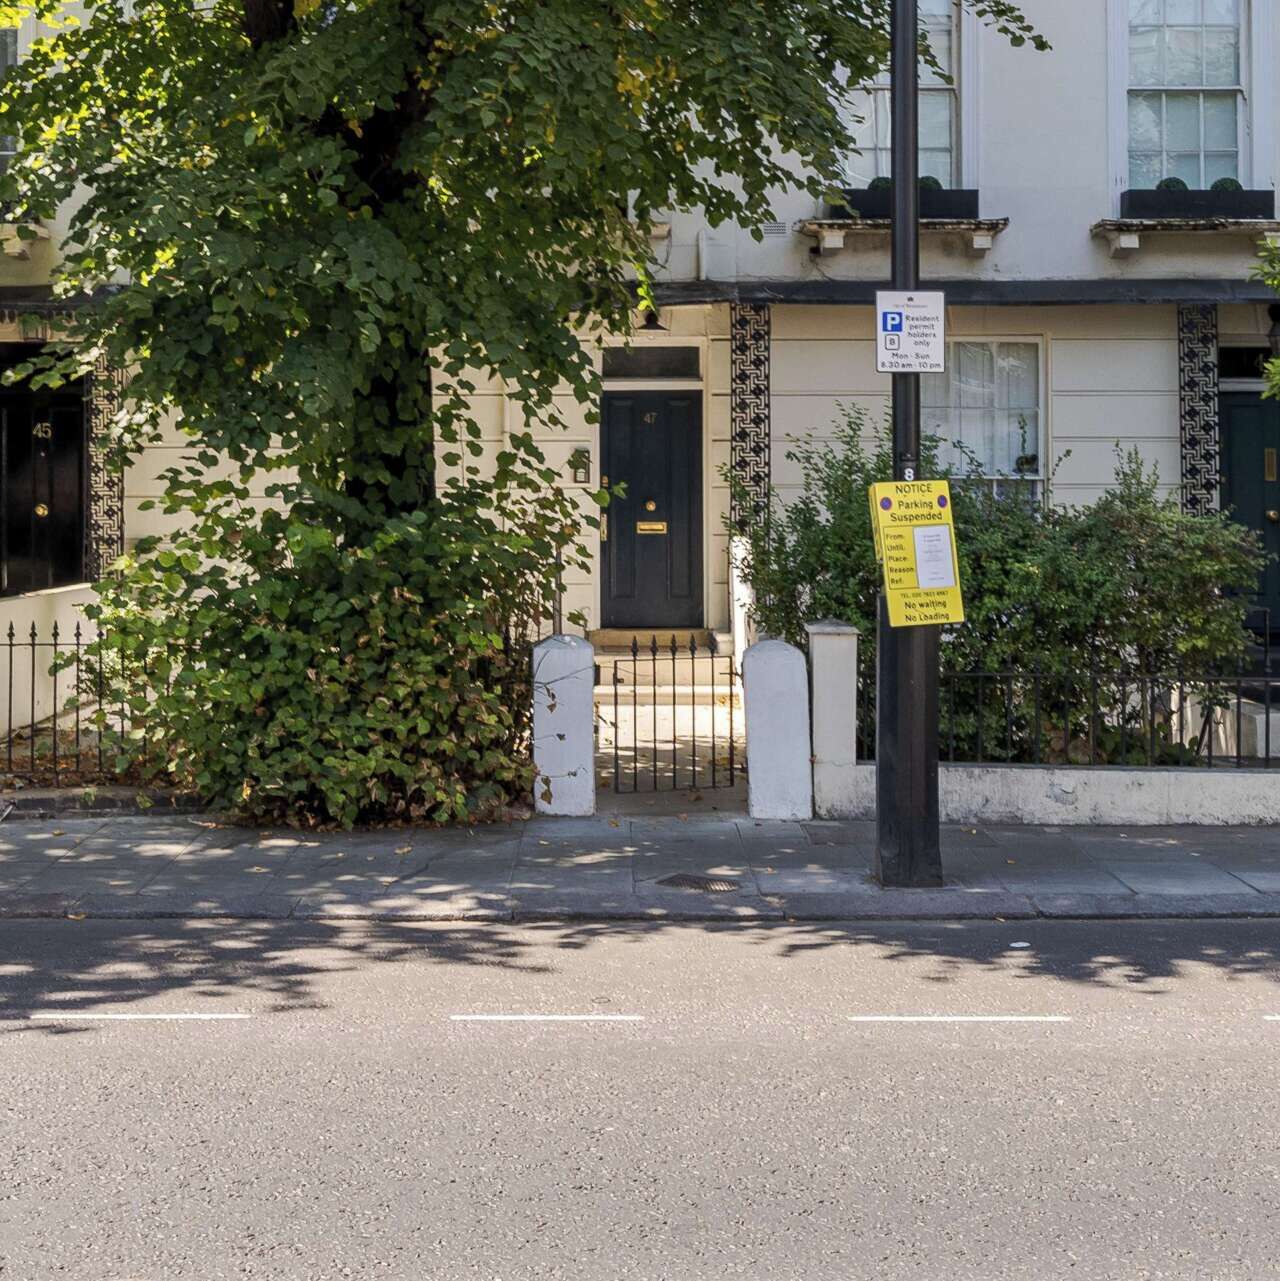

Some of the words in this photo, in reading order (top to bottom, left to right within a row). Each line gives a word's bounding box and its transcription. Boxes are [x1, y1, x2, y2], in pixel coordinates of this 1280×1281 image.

[887, 313, 901, 331] P
[905, 314, 940, 322] Resident
[909, 323, 935, 331] permit
[913, 339, 931, 347] only
[891, 352, 909, 360] Mon
[914, 352, 930, 360] Sun
[32, 422, 52, 439] 45
[903, 467, 915, 481] 8
[895, 483, 933, 494] NOTICE
[898, 500, 933, 510] Parking
[890, 512, 943, 523] Suspended
[904, 601, 916, 609] No
[918, 600, 947, 609] waiting
[904, 614, 917, 622] No
[919, 612, 950, 621] Loading
